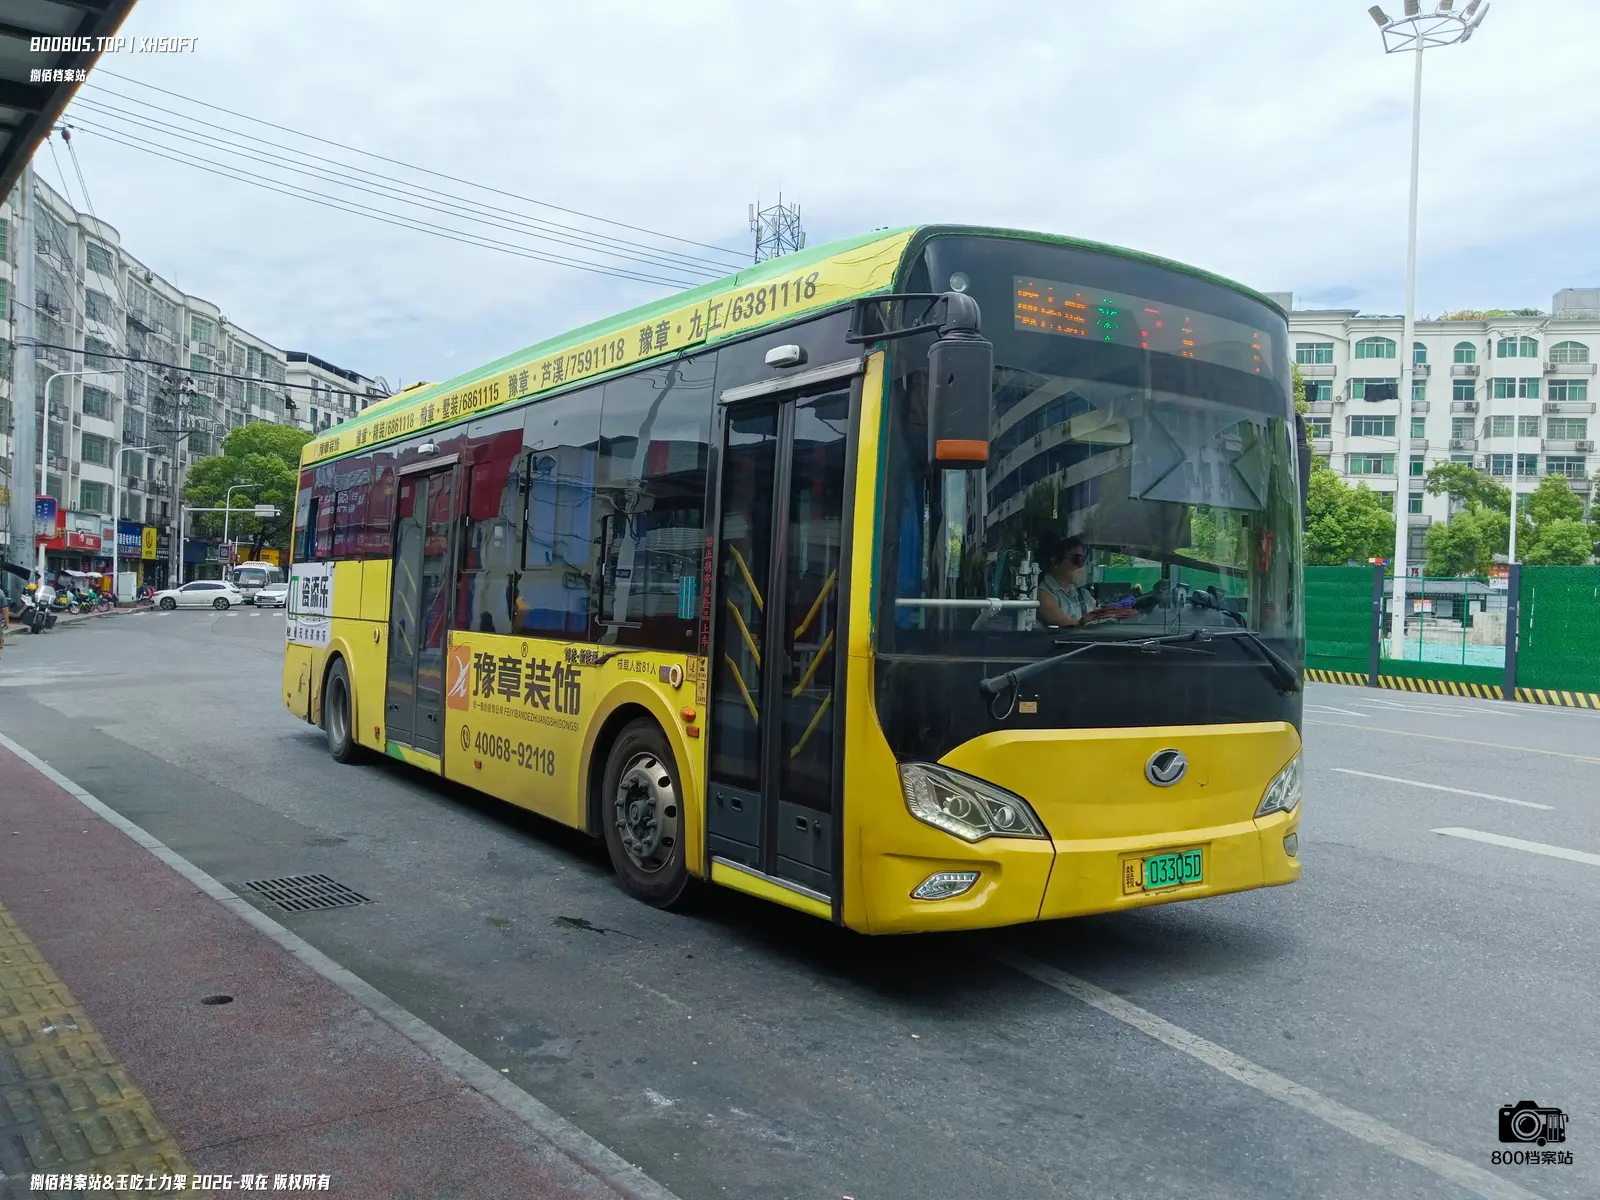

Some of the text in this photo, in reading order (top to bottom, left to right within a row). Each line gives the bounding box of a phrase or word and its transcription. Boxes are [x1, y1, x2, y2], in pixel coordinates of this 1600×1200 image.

[472, 652, 581, 715] 豫章装饰
[474, 731, 555, 777] 40068-92118
